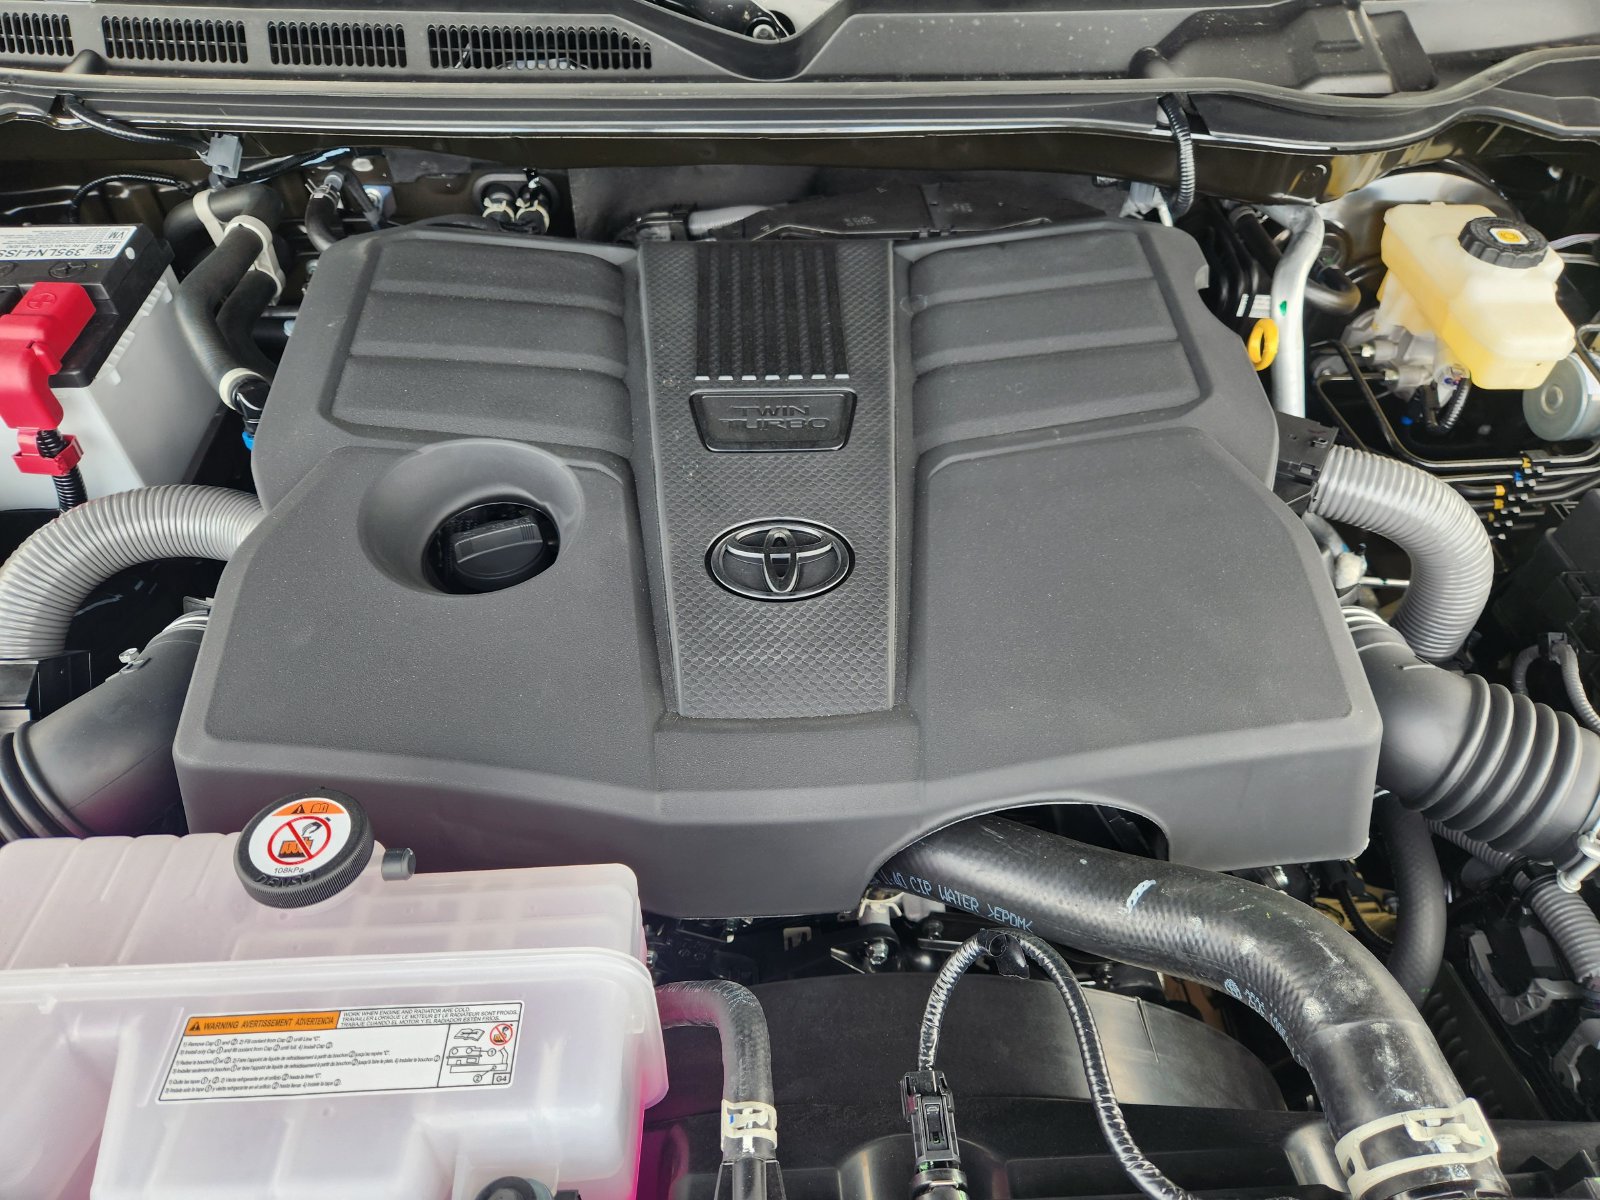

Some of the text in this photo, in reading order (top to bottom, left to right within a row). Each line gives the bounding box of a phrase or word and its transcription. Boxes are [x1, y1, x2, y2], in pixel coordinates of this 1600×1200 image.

[730, 405, 809, 416] TWIN
[719, 418, 830, 430] TURBO
[938, 884, 979, 912] WATER
[204, 1016, 334, 1030] WARNING AVERTISSEMENT ADVERTENCIA
